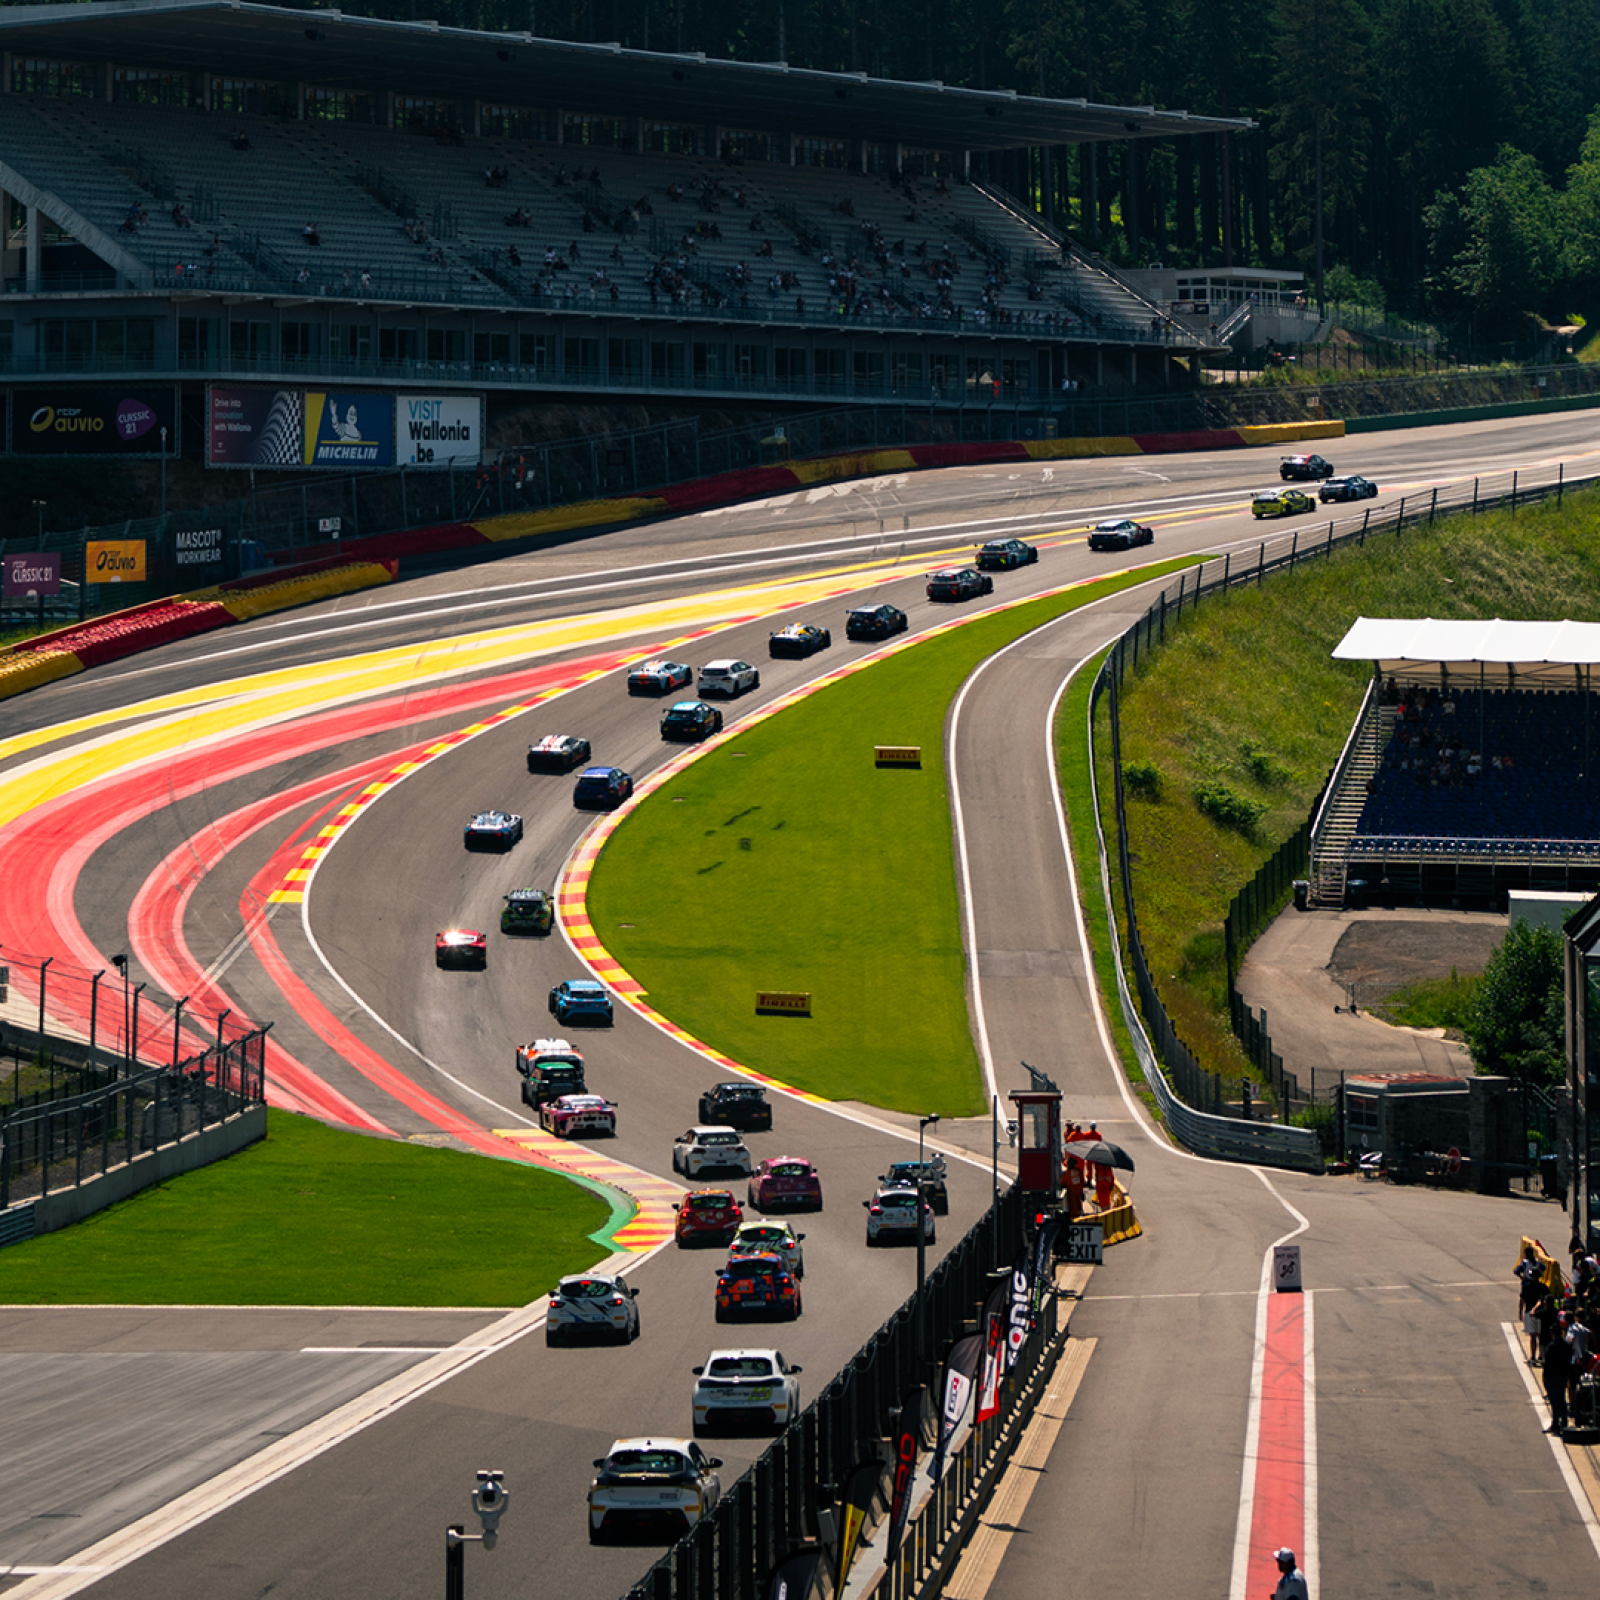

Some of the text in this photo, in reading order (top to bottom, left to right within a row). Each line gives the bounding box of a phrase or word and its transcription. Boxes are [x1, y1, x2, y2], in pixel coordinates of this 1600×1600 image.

[408, 400, 443, 419] VISIT
[118, 410, 151, 424] CLASSIC
[54, 417, 104, 432] auvio
[125, 422, 137, 434] 21
[408, 419, 470, 441] Wallonia
[317, 446, 378, 460] MICHELIN
[107, 557, 136, 570] auvio
[176, 549, 221, 564] WORKWEAR
[12, 566, 53, 583] CLASSIC 21
[879, 750, 917, 759] PIRELLI
[760, 995, 806, 1007] PIRELLI
[1071, 1227, 1093, 1242] PIT
[1067, 1244, 1098, 1258] EXIT
